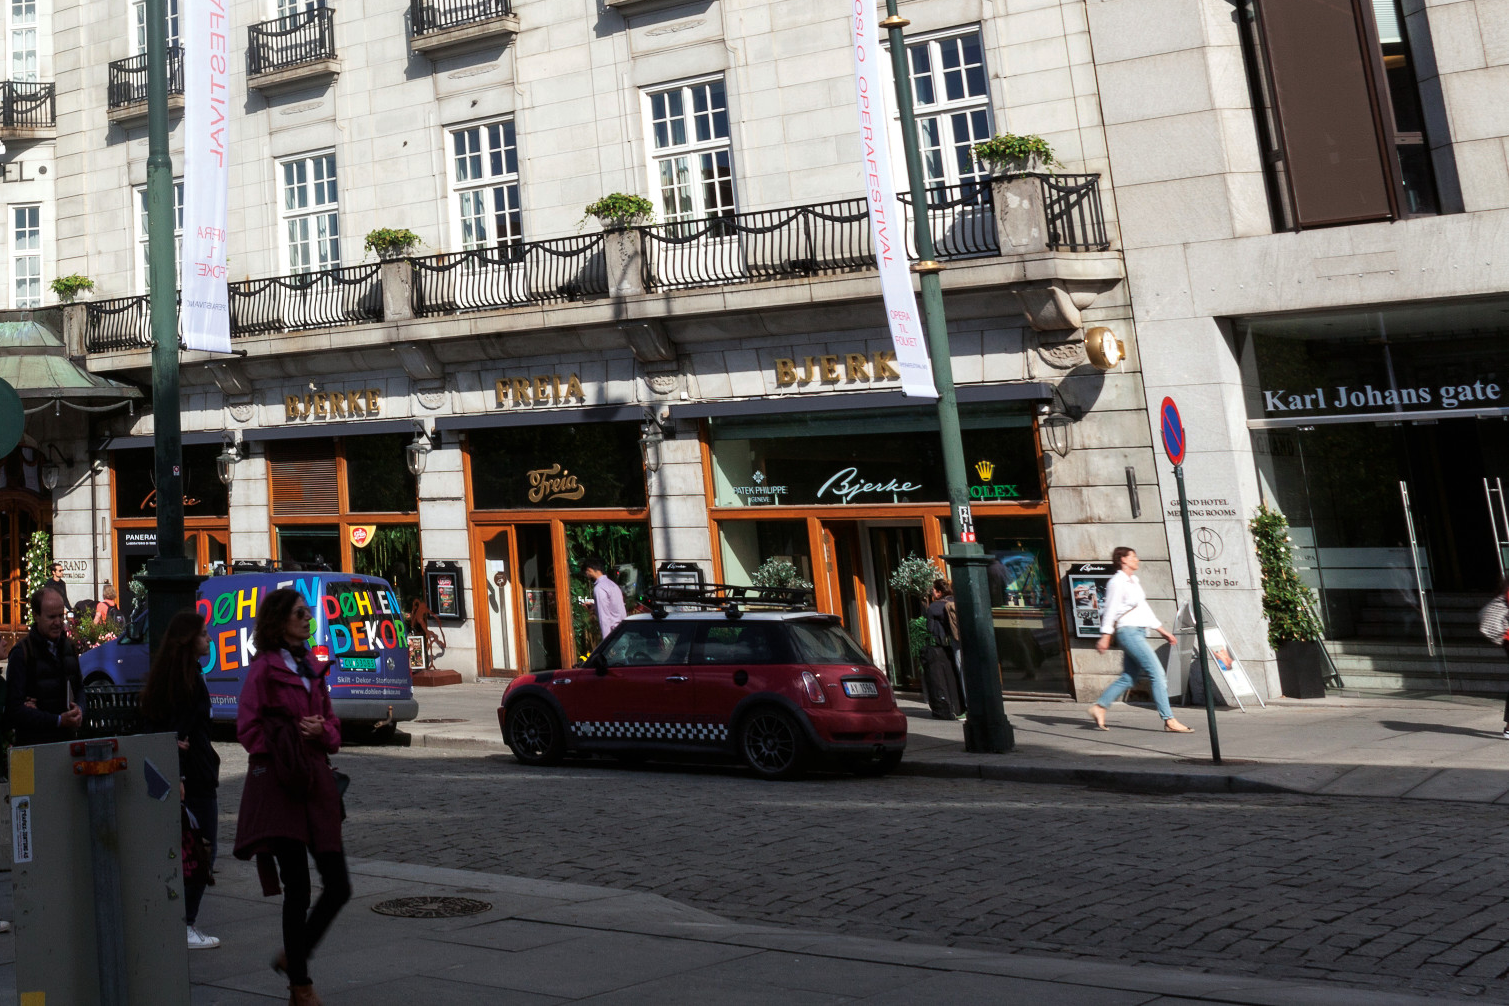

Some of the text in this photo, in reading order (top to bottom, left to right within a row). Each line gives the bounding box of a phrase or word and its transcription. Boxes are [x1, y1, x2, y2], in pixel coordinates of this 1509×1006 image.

[858, 75, 893, 269] OPERAFESTIVAL
[890, 309, 912, 322] OPERA
[898, 323, 909, 334] TIL
[894, 335, 917, 347] FOLKET
[774, 350, 901, 385] BJERK
[495, 372, 586, 403] FREIA
[1263, 379, 1502, 411] Karl Johans gate
[285, 388, 381, 417] BJERKE
[526, 463, 585, 503] Freia
[733, 485, 788, 495] PATEK PHILIPPE
[817, 467, 922, 501] Bjerke
[968, 484, 1019, 498] OLEX
[1186, 579, 1221, 587] Roftop
[321, 590, 401, 620] DØHLEN
[328, 619, 408, 654] DEKOR
[355, 676, 371, 684] Dekor
